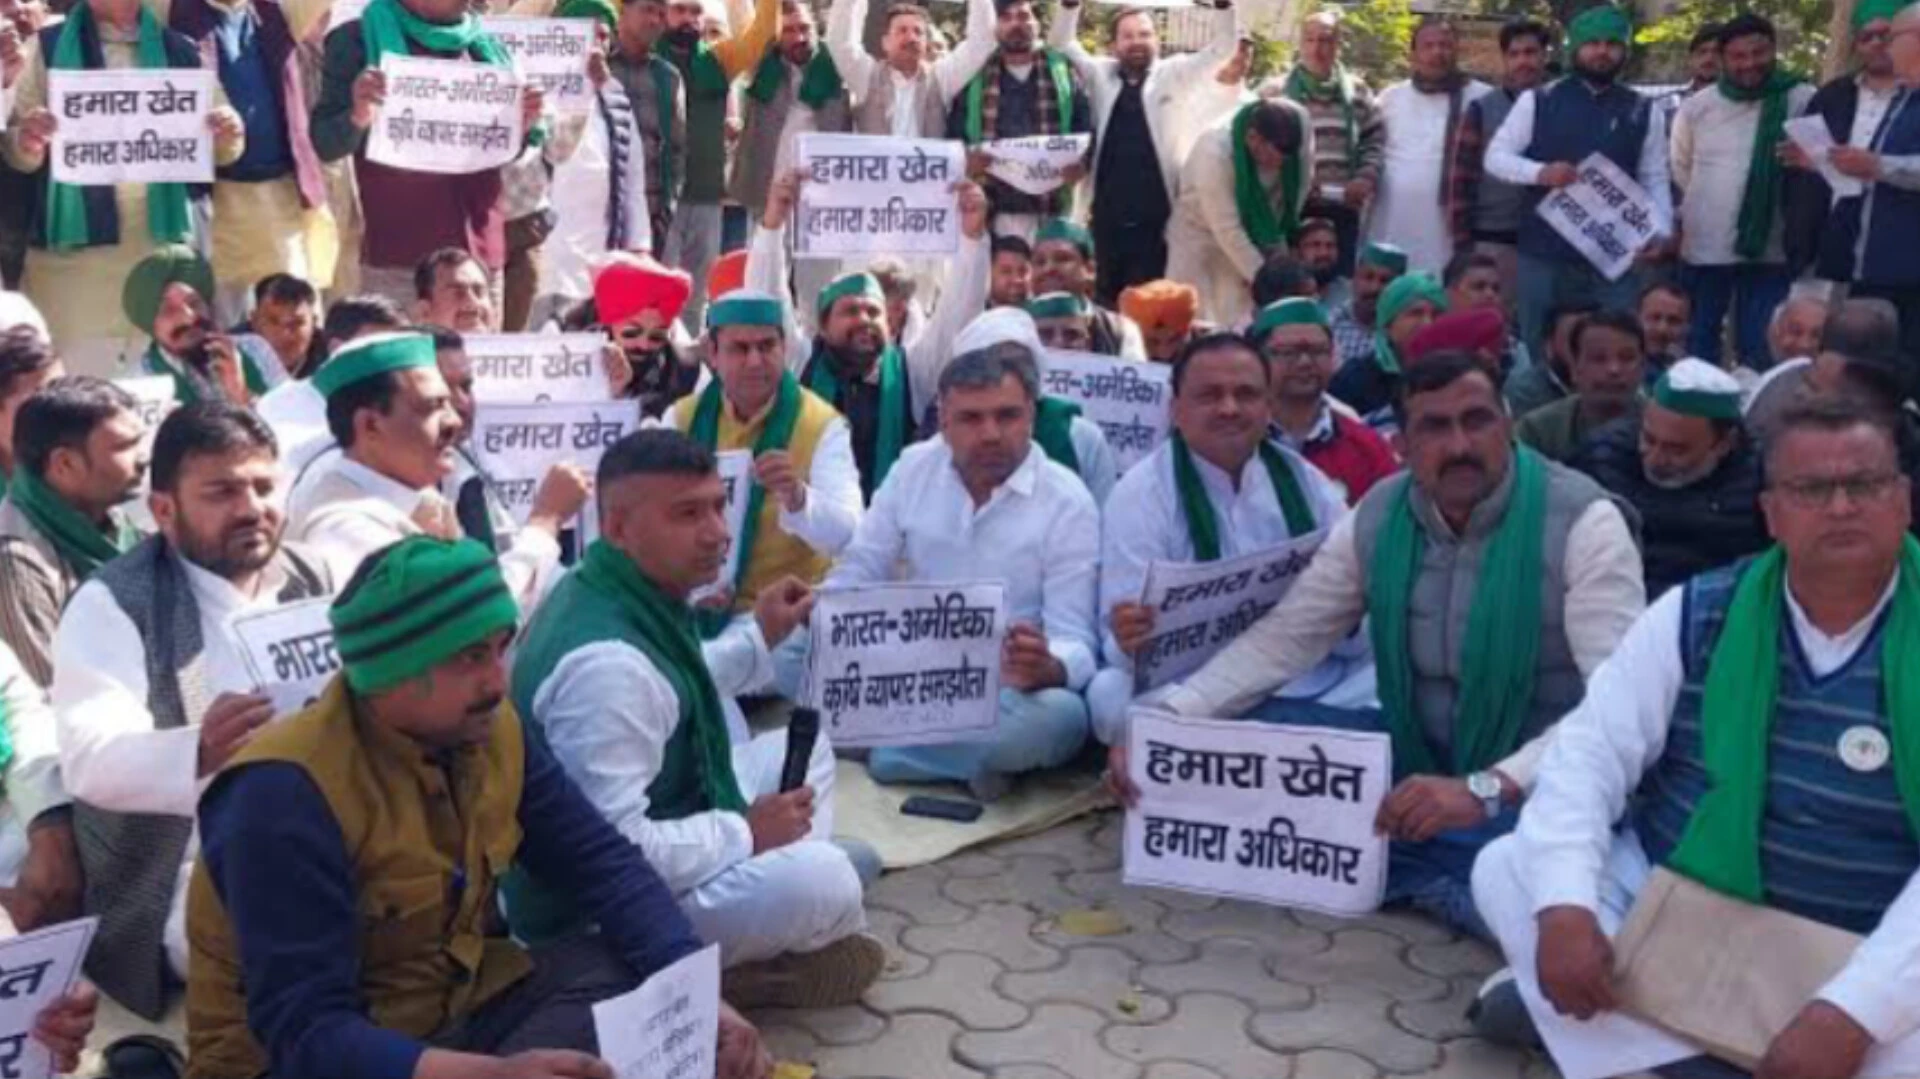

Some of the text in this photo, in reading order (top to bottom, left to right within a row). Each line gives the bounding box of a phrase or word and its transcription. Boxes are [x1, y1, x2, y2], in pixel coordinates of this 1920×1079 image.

[63, 80, 197, 118] हमारा खेत
[63, 128, 198, 168] हमारा अधिकार
[809, 154, 891, 185] हमारा
[897, 146, 948, 184] खेत
[808, 196, 948, 236] हमारा अधिकार
[474, 344, 593, 380] मारा खेत
[1042, 365, 1163, 405] रत-अमेरिका
[484, 414, 625, 453] हमारा खेत
[1160, 568, 1254, 613] हमारा
[831, 591, 995, 648] भारत-अमेरिका
[1147, 598, 1280, 669] हमारा अधिक
[822, 652, 988, 727] कृषि व्यापार समझौता
[1145, 739, 1367, 803] हमारा खेत
[1143, 815, 1364, 886] हमारा अधिकार
